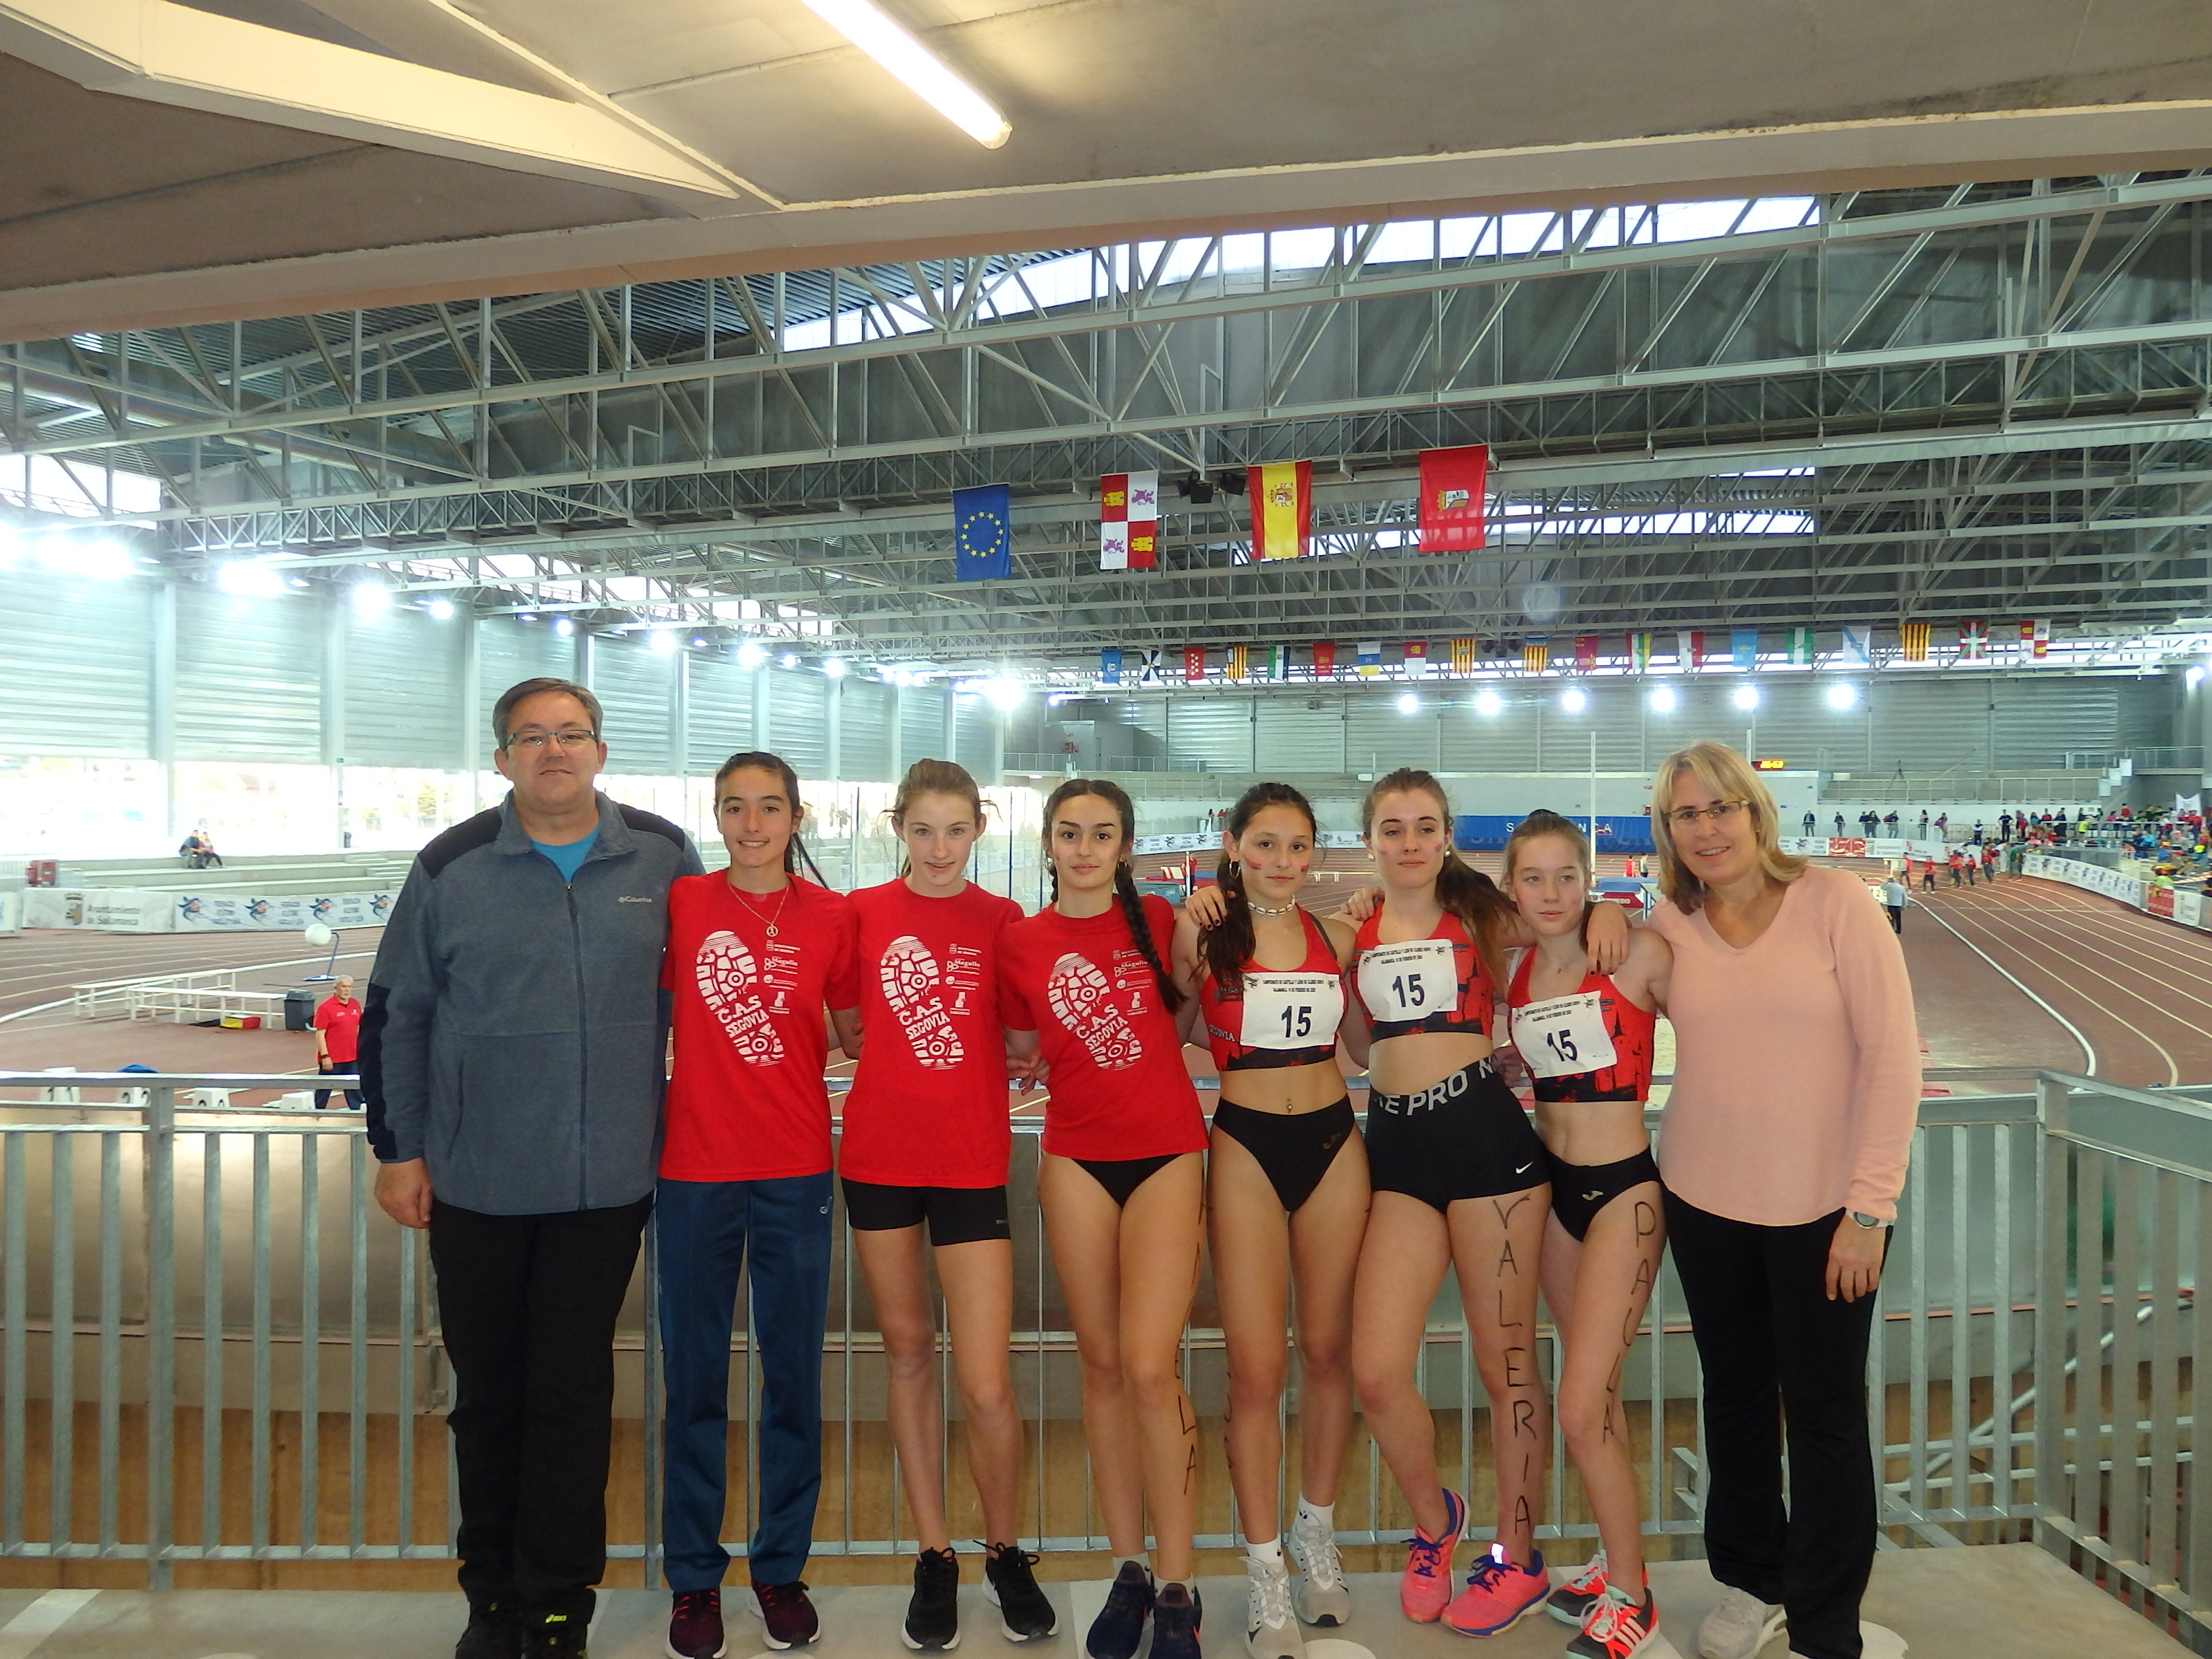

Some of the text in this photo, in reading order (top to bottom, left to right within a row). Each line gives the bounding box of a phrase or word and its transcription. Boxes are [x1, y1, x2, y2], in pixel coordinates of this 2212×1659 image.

[1392, 973, 1425, 1008] 15
[725, 1009, 770, 1038] SEGOVIA
[905, 1011, 951, 1041] SEGOVIA
[1085, 1015, 1129, 1051] SEGOVIA
[1281, 1005, 1312, 1038] 15
[1547, 1029, 1578, 1062] 15
[1407, 1070, 1468, 1116] PRO
[1493, 1193, 1537, 1535] VALERIA
